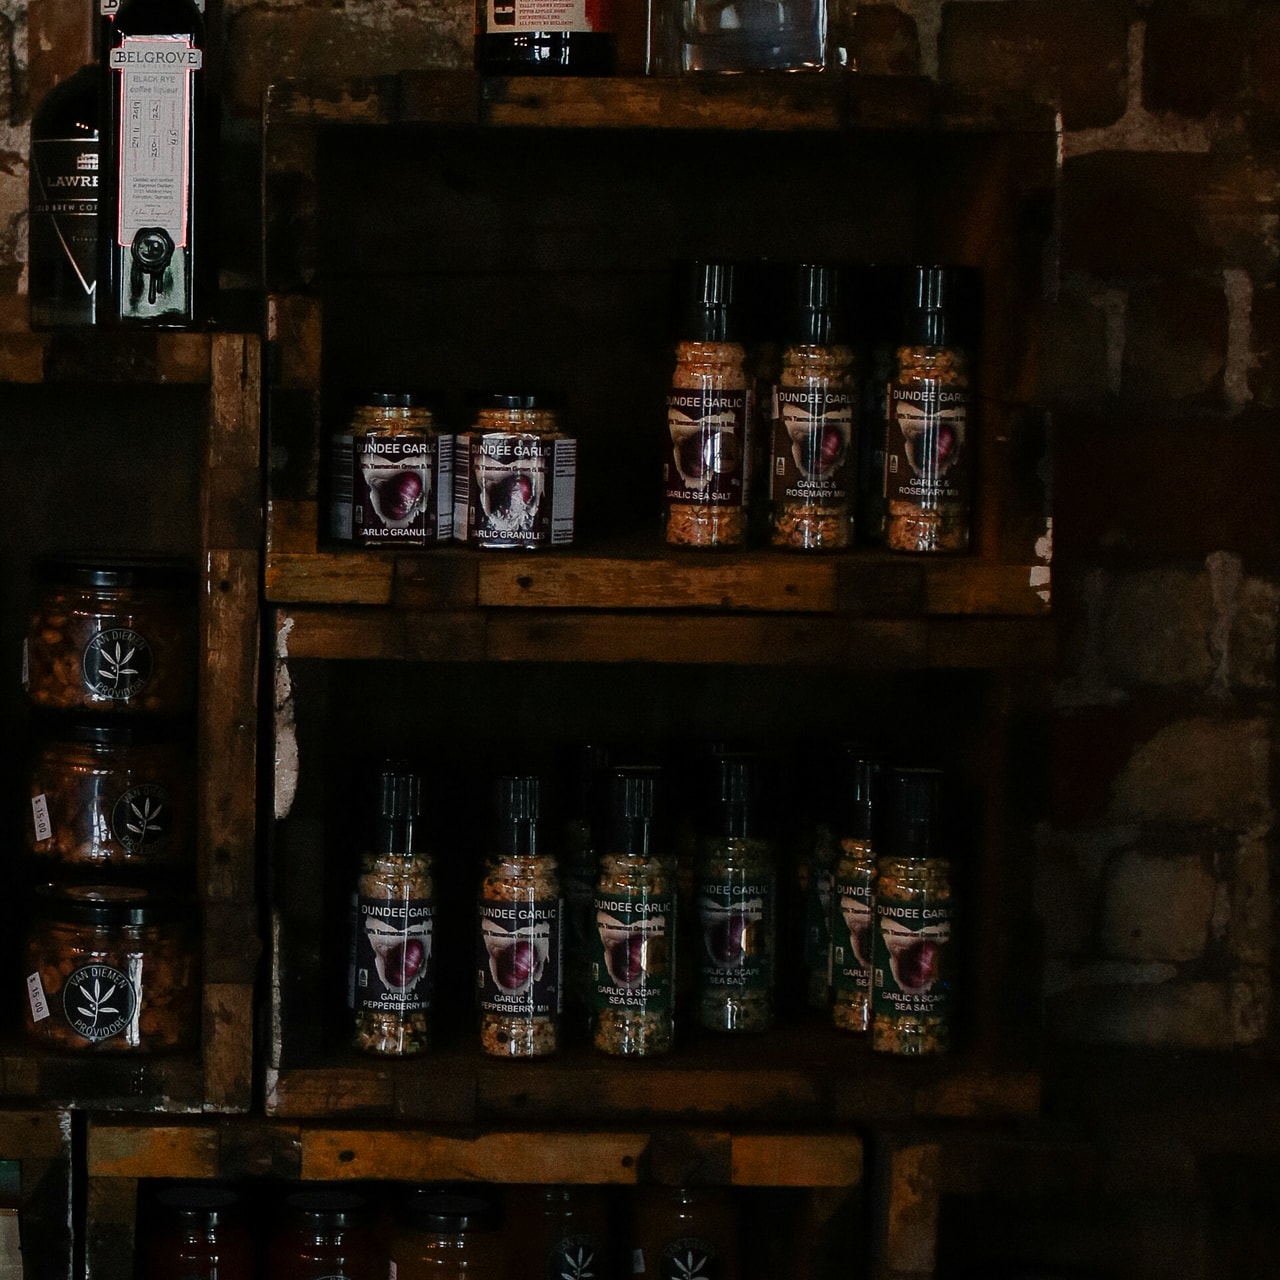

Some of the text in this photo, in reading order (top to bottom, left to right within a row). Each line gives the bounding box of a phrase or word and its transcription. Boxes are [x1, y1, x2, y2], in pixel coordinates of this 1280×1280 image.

[114, 52, 198, 64] BELGROVE
[779, 392, 823, 404] DUNDEE
[893, 390, 936, 402] DUNDEE
[666, 395, 743, 409] DUNDEE GARLIC
[357, 443, 400, 455] DUNDEE
[472, 444, 552, 457] DUNDEE GARLIC
[797, 479, 829, 489] GARLIC
[909, 477, 942, 488] GARLIC
[693, 491, 732, 501] SEA SALT
[785, 488, 834, 499] ROSEMARY
[898, 487, 946, 497] ROSEMARY
[500, 530, 545, 540] GRANULES
[91, 629, 146, 651] VAN DIEMEN
[95, 678, 146, 698] PROVIDORE
[732, 885, 769, 896] GARLIC
[593, 898, 671, 913] DUNDEE GARLIC
[878, 904, 920, 918] DUNDEE
[361, 905, 407, 919] DUNDEE
[479, 906, 557, 921] DUNDEE GARLIC
[70, 967, 128, 989] VAN DIEMEN
[734, 968, 760, 977] SCAPE
[710, 977, 747, 986] SEA SALT
[380, 992, 412, 1002] GARLIC
[597, 986, 661, 997] GARLIC SCAPE
[882, 992, 911, 1001] GARLIC
[493, 994, 525, 1004] GARLIC
[609, 997, 649, 1006] SEA SALT
[363, 1000, 420, 1012] PEPPERBERRY
[481, 1002, 550, 1013] PEPPERBERRY MIX
[894, 1002, 934, 1012] SEA SALT
[74, 1015, 128, 1037] PROVIDORE
